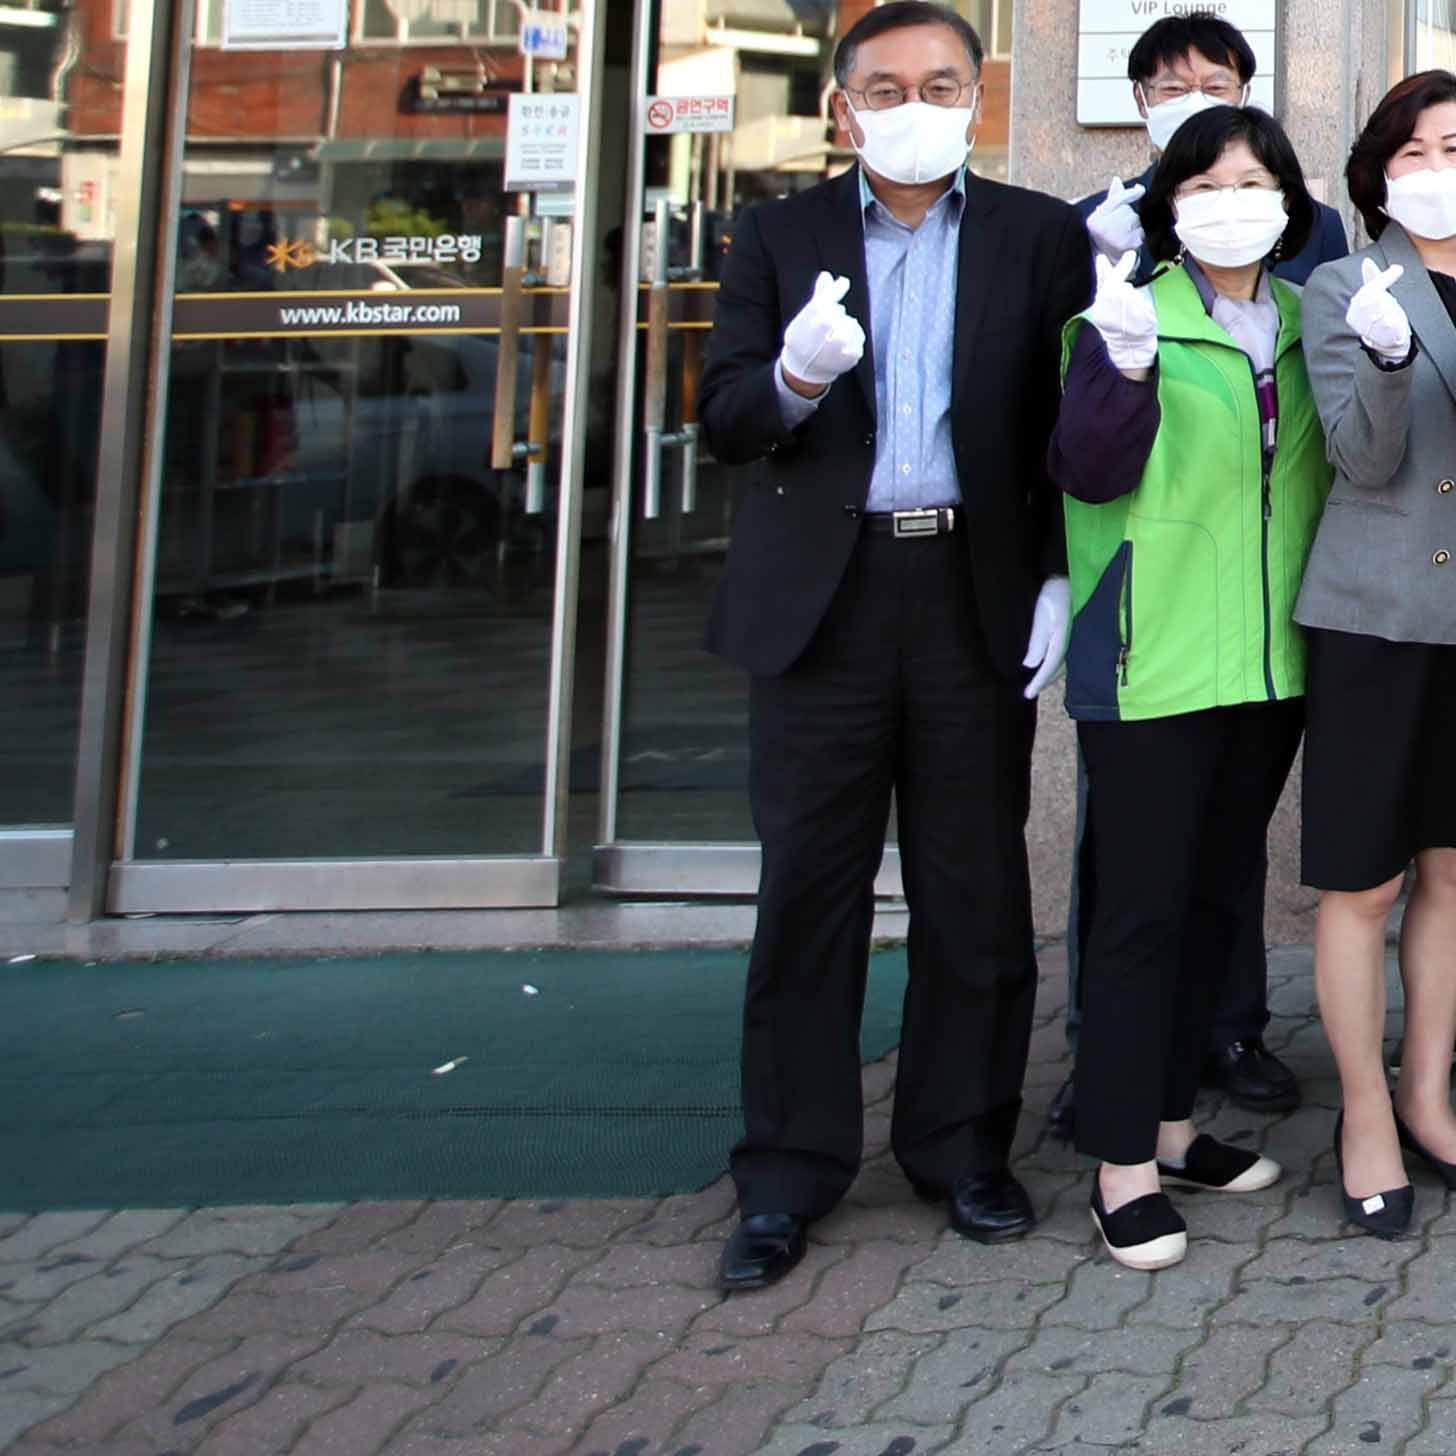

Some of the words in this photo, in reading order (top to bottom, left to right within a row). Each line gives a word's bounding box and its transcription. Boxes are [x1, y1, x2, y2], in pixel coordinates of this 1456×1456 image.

[1131, 0, 1158, 15] VIP
[676, 98, 729, 115] 금연구역
[280, 300, 460, 326] www.kbstar.com
